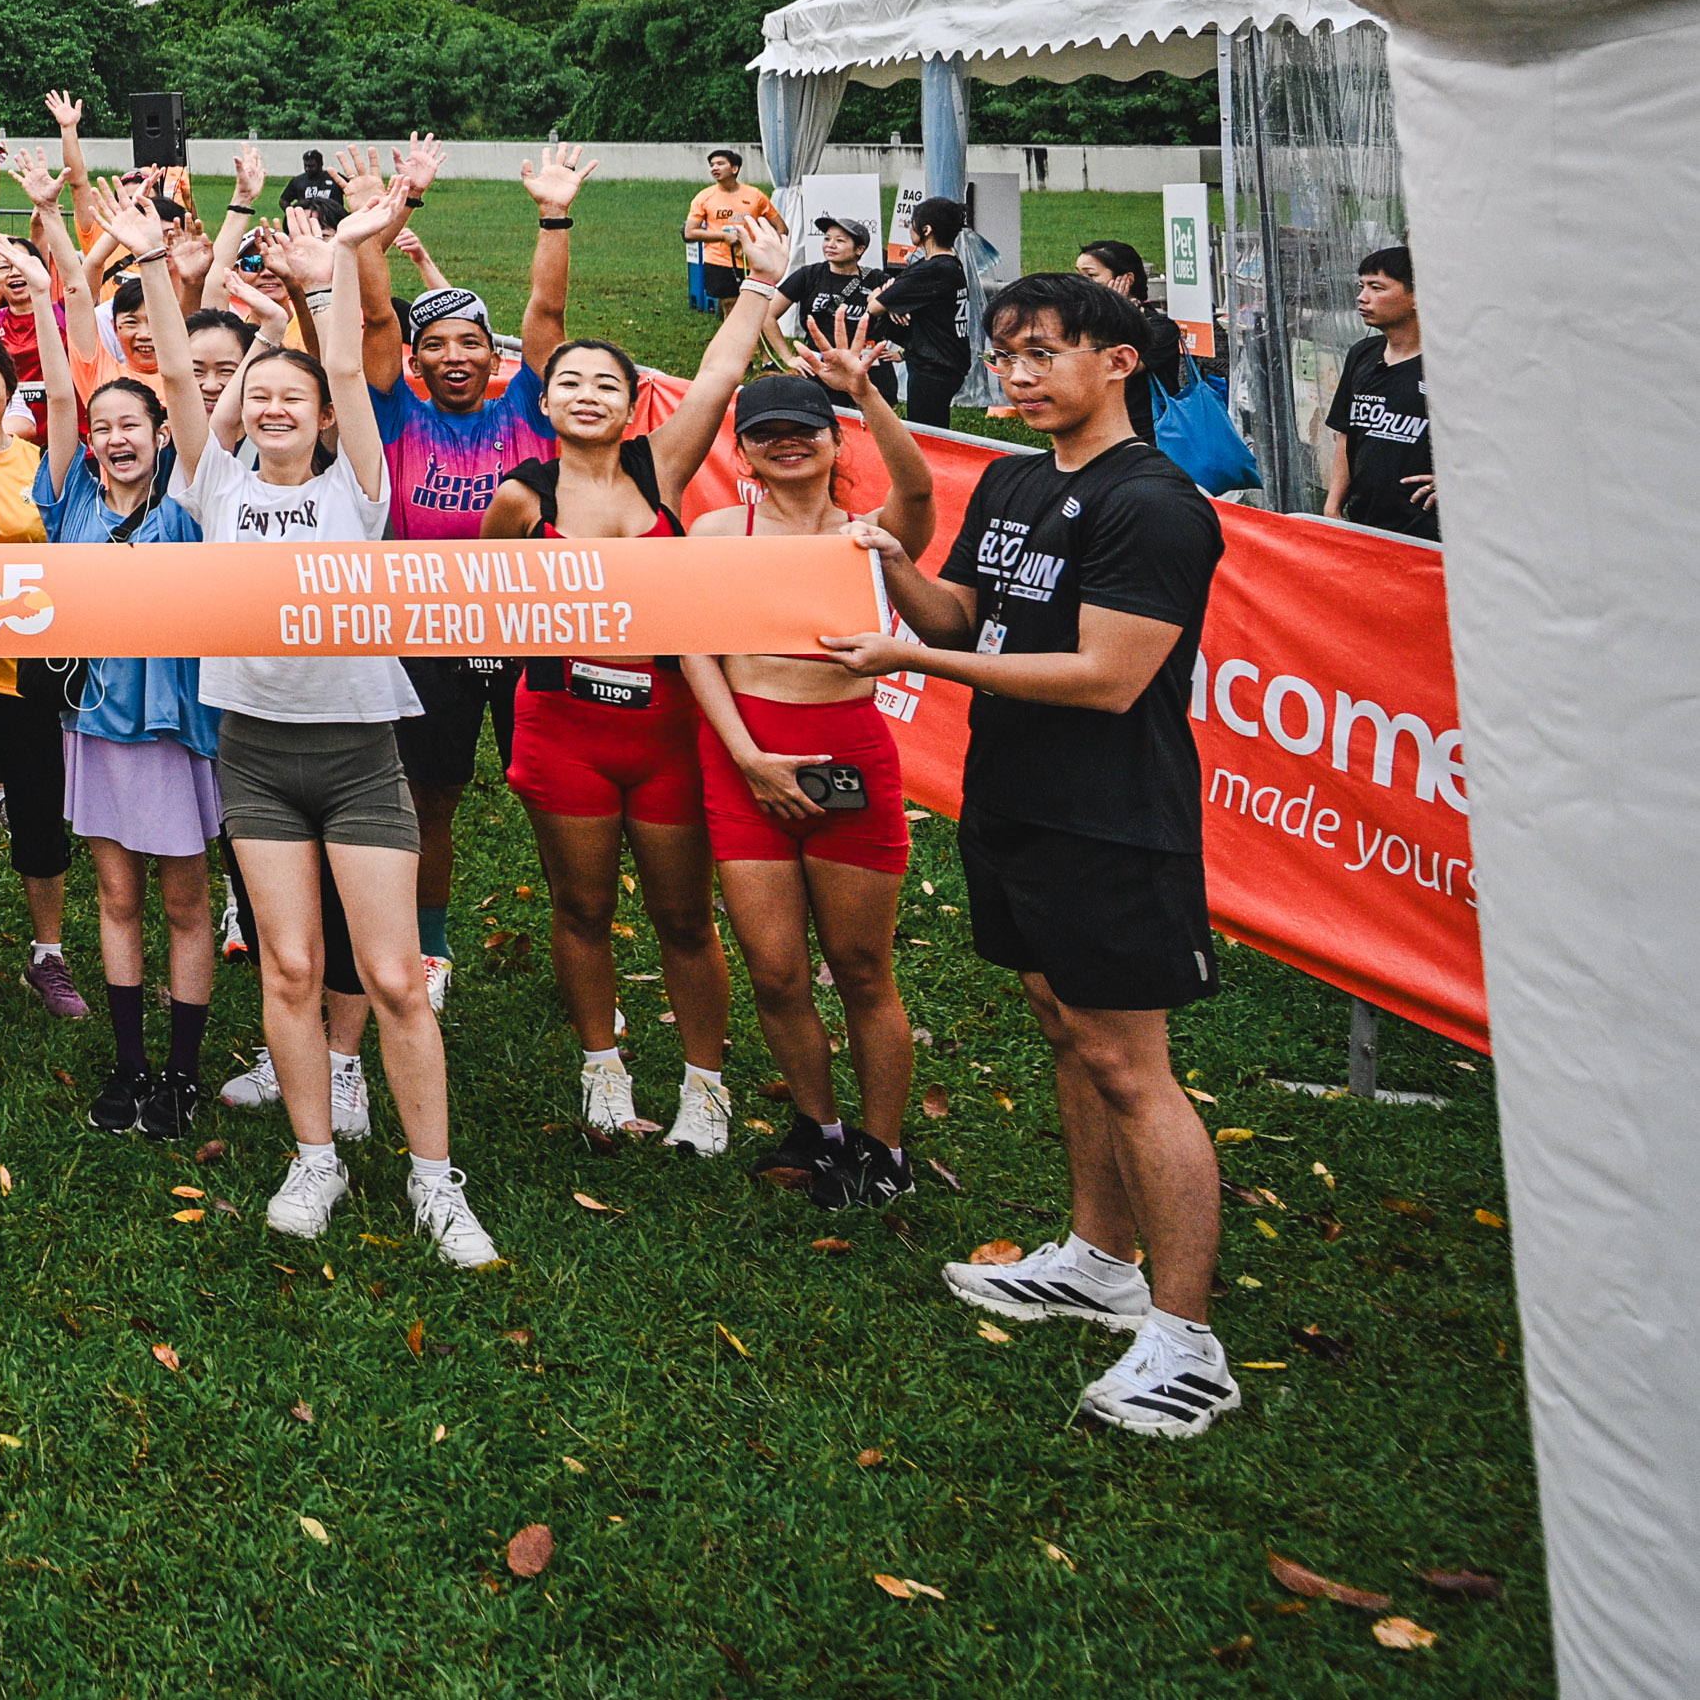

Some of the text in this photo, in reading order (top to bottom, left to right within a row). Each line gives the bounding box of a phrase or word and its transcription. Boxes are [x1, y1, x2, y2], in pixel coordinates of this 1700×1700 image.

[902, 189, 923, 202] BAG
[1173, 222, 1194, 257] Pet
[1174, 260, 1195, 279] CUBES
[412, 291, 469, 319] PRECISION
[417, 314, 432, 324] FUEL
[437, 294, 472, 314] HYDRATION
[294, 550, 606, 594] HOW FAR WILL YOU
[279, 601, 632, 645] GO FOR ZERO WASTE?
[467, 657, 503, 670] 10114
[591, 682, 632, 701] 11190
[876, 688, 898, 708] ASTE
[1208, 766, 1341, 850] made
